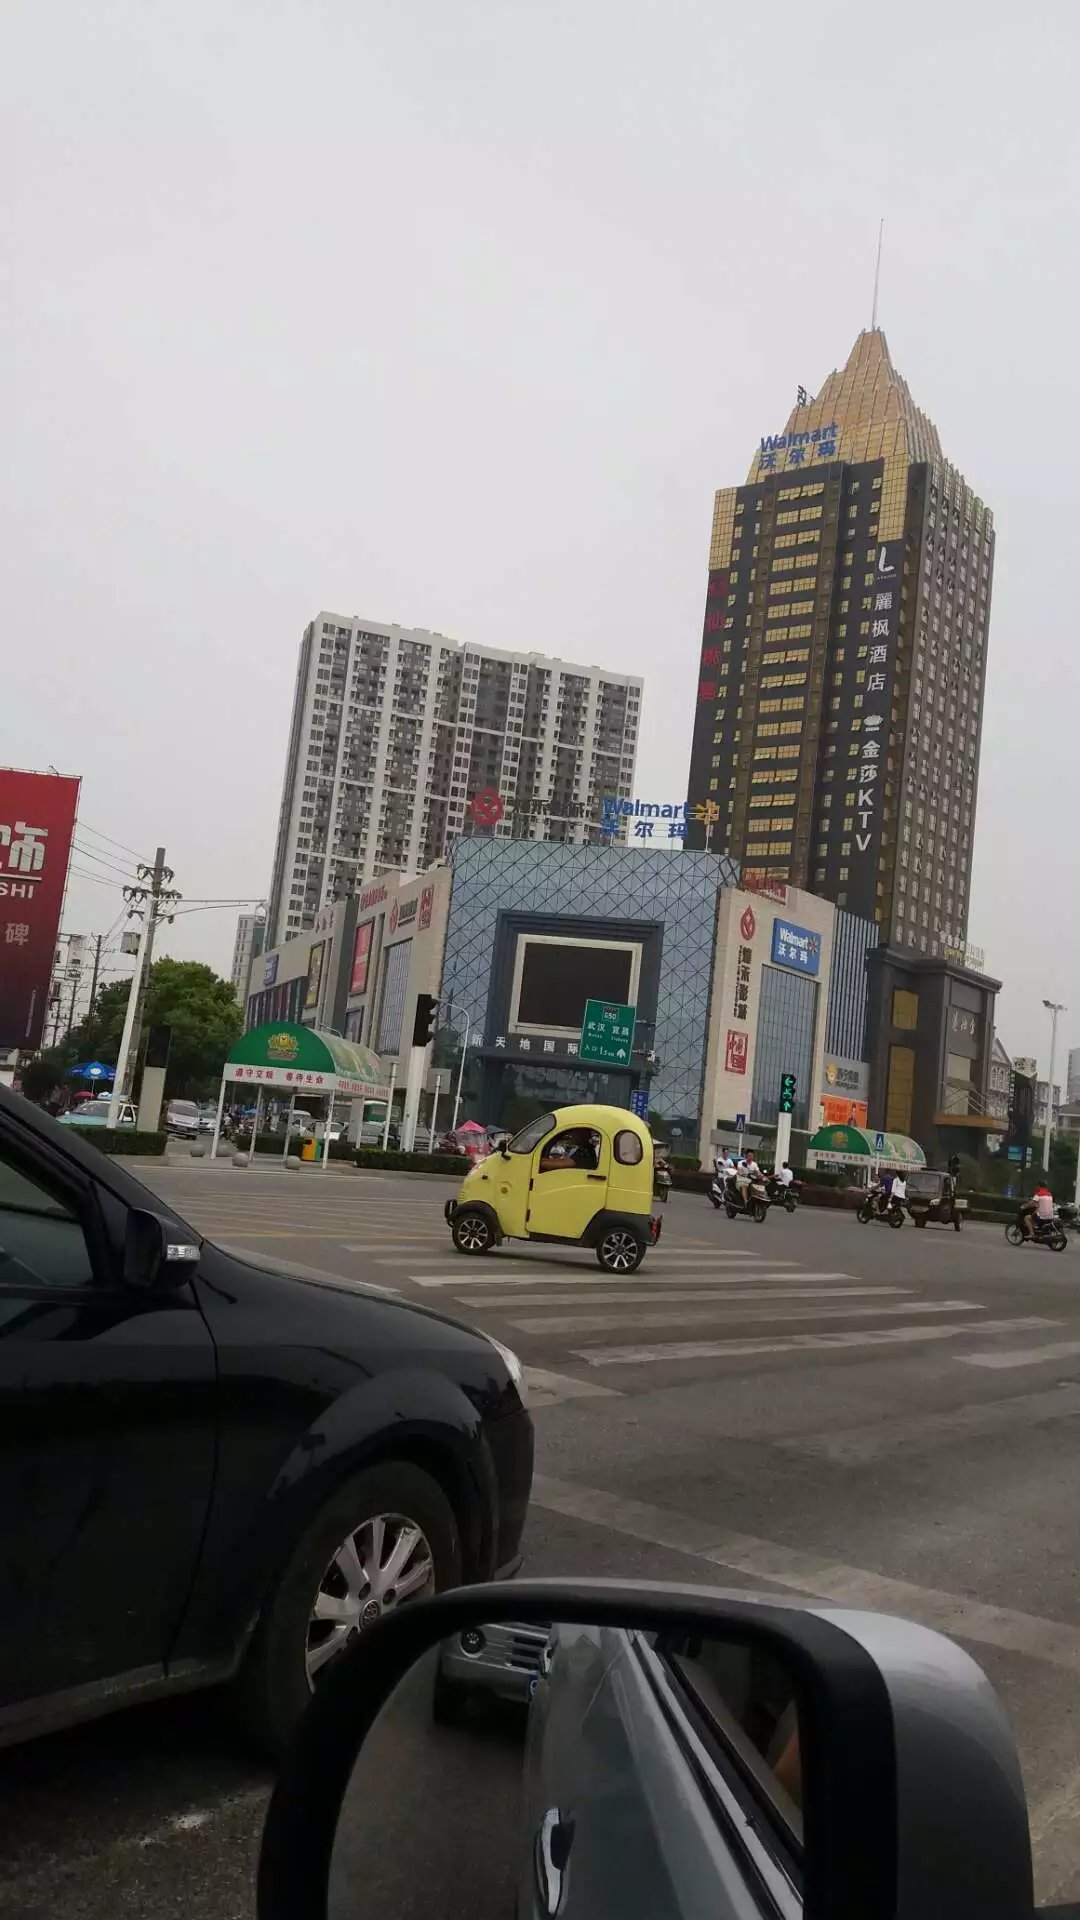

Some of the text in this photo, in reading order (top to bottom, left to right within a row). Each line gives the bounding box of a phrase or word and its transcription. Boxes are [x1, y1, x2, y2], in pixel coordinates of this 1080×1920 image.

[760, 421, 838, 452] Walmart
[867, 592, 893, 693] 麗枫酒店
[602, 796, 692, 819] Walmart
[780, 927, 809, 950] Walmart
